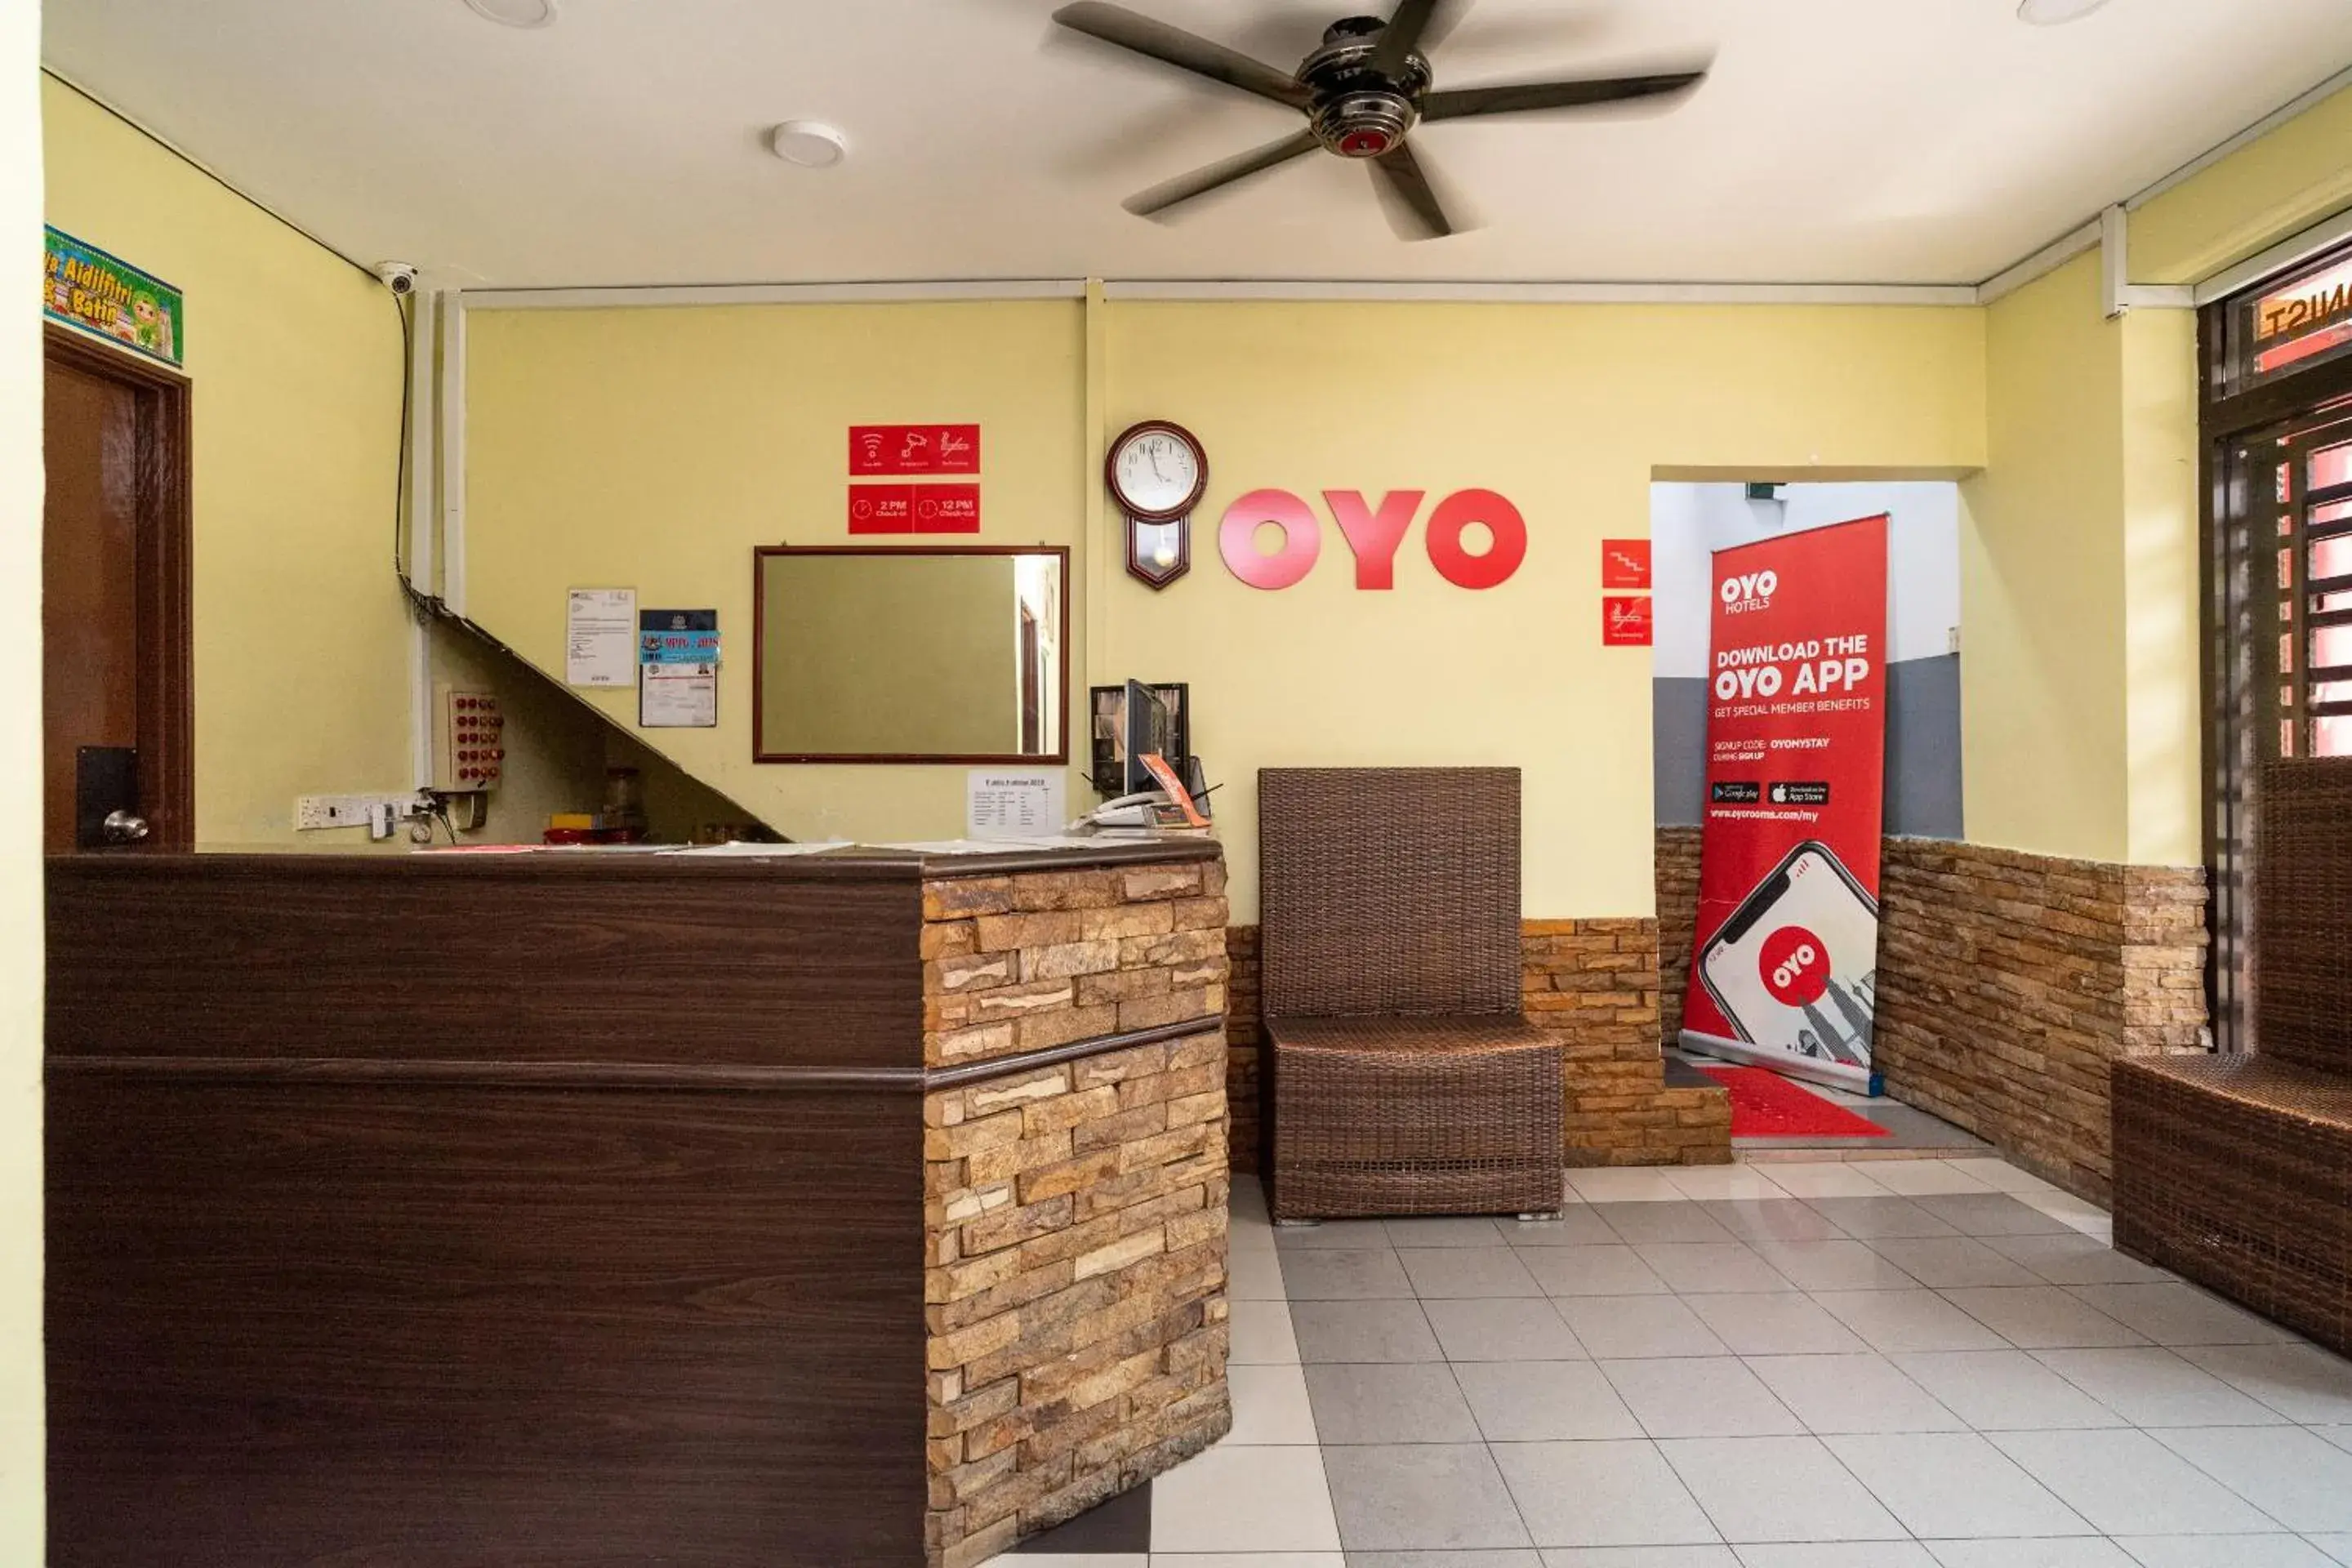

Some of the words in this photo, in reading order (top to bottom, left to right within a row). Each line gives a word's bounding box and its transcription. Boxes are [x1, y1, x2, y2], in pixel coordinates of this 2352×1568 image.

[73, 288, 117, 323] Batin
[880, 501, 889, 510] 2
[889, 501, 907, 510] PM
[942, 501, 954, 509] 12
[956, 500, 973, 509] PM
[1218, 488, 1527, 590] OYO
[1721, 571, 1777, 603] OYO
[1726, 596, 1770, 614] HOTELS
[1717, 639, 1820, 668] DOWNLOAD
[1824, 635, 1868, 656] THE
[1715, 666, 1782, 700] OYO
[1793, 658, 1869, 694] APP
[1715, 706, 1732, 718] GET
[1733, 703, 1768, 717] SPECIAL
[1771, 701, 1815, 714] MEMBER
[1817, 697, 1870, 712] BENEFITS
[1724, 789, 1746, 799] Google
[1788, 793, 1804, 802] App
[1804, 793, 1823, 801] Store
[1773, 944, 1815, 987] OYO
